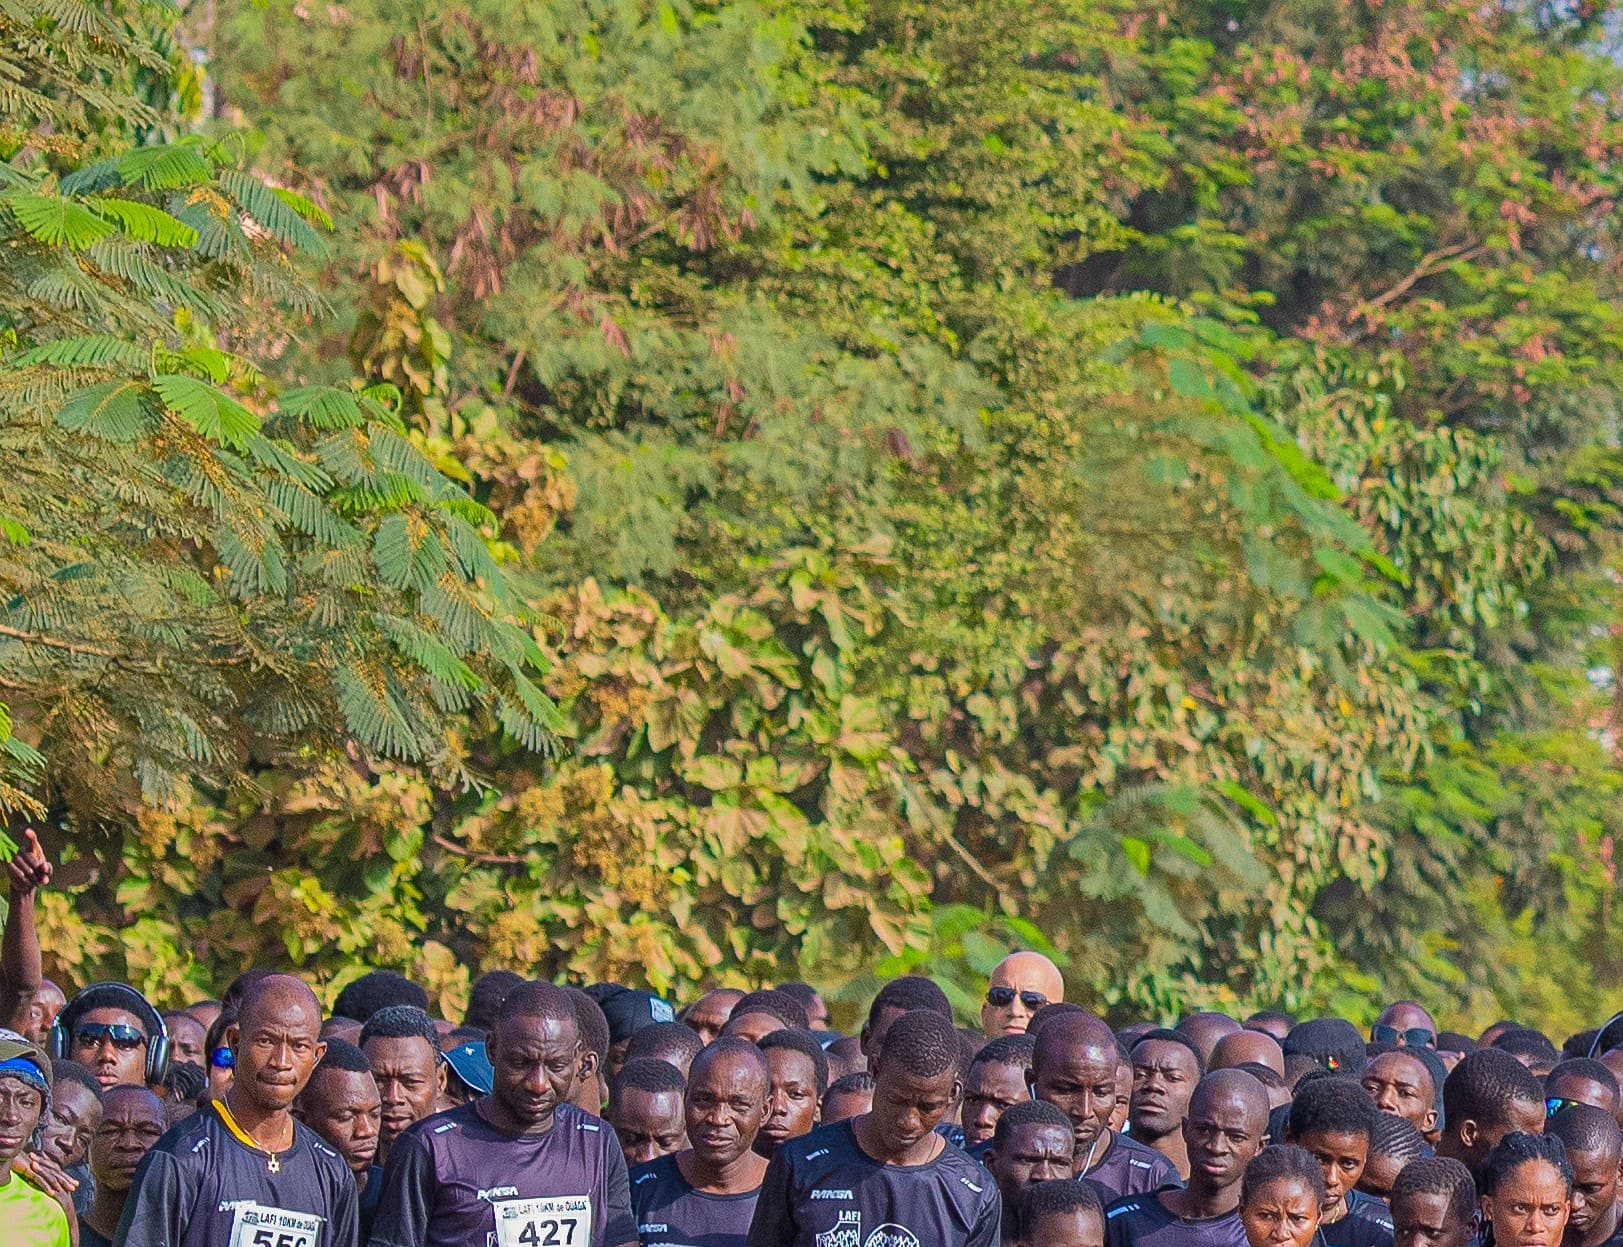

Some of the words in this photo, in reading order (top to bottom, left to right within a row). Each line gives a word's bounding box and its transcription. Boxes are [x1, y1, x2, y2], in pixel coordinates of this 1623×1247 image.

[260, 1212, 277, 1225] LAFI
[839, 1210, 861, 1221] LAFI
[518, 1218, 578, 1247] 427
